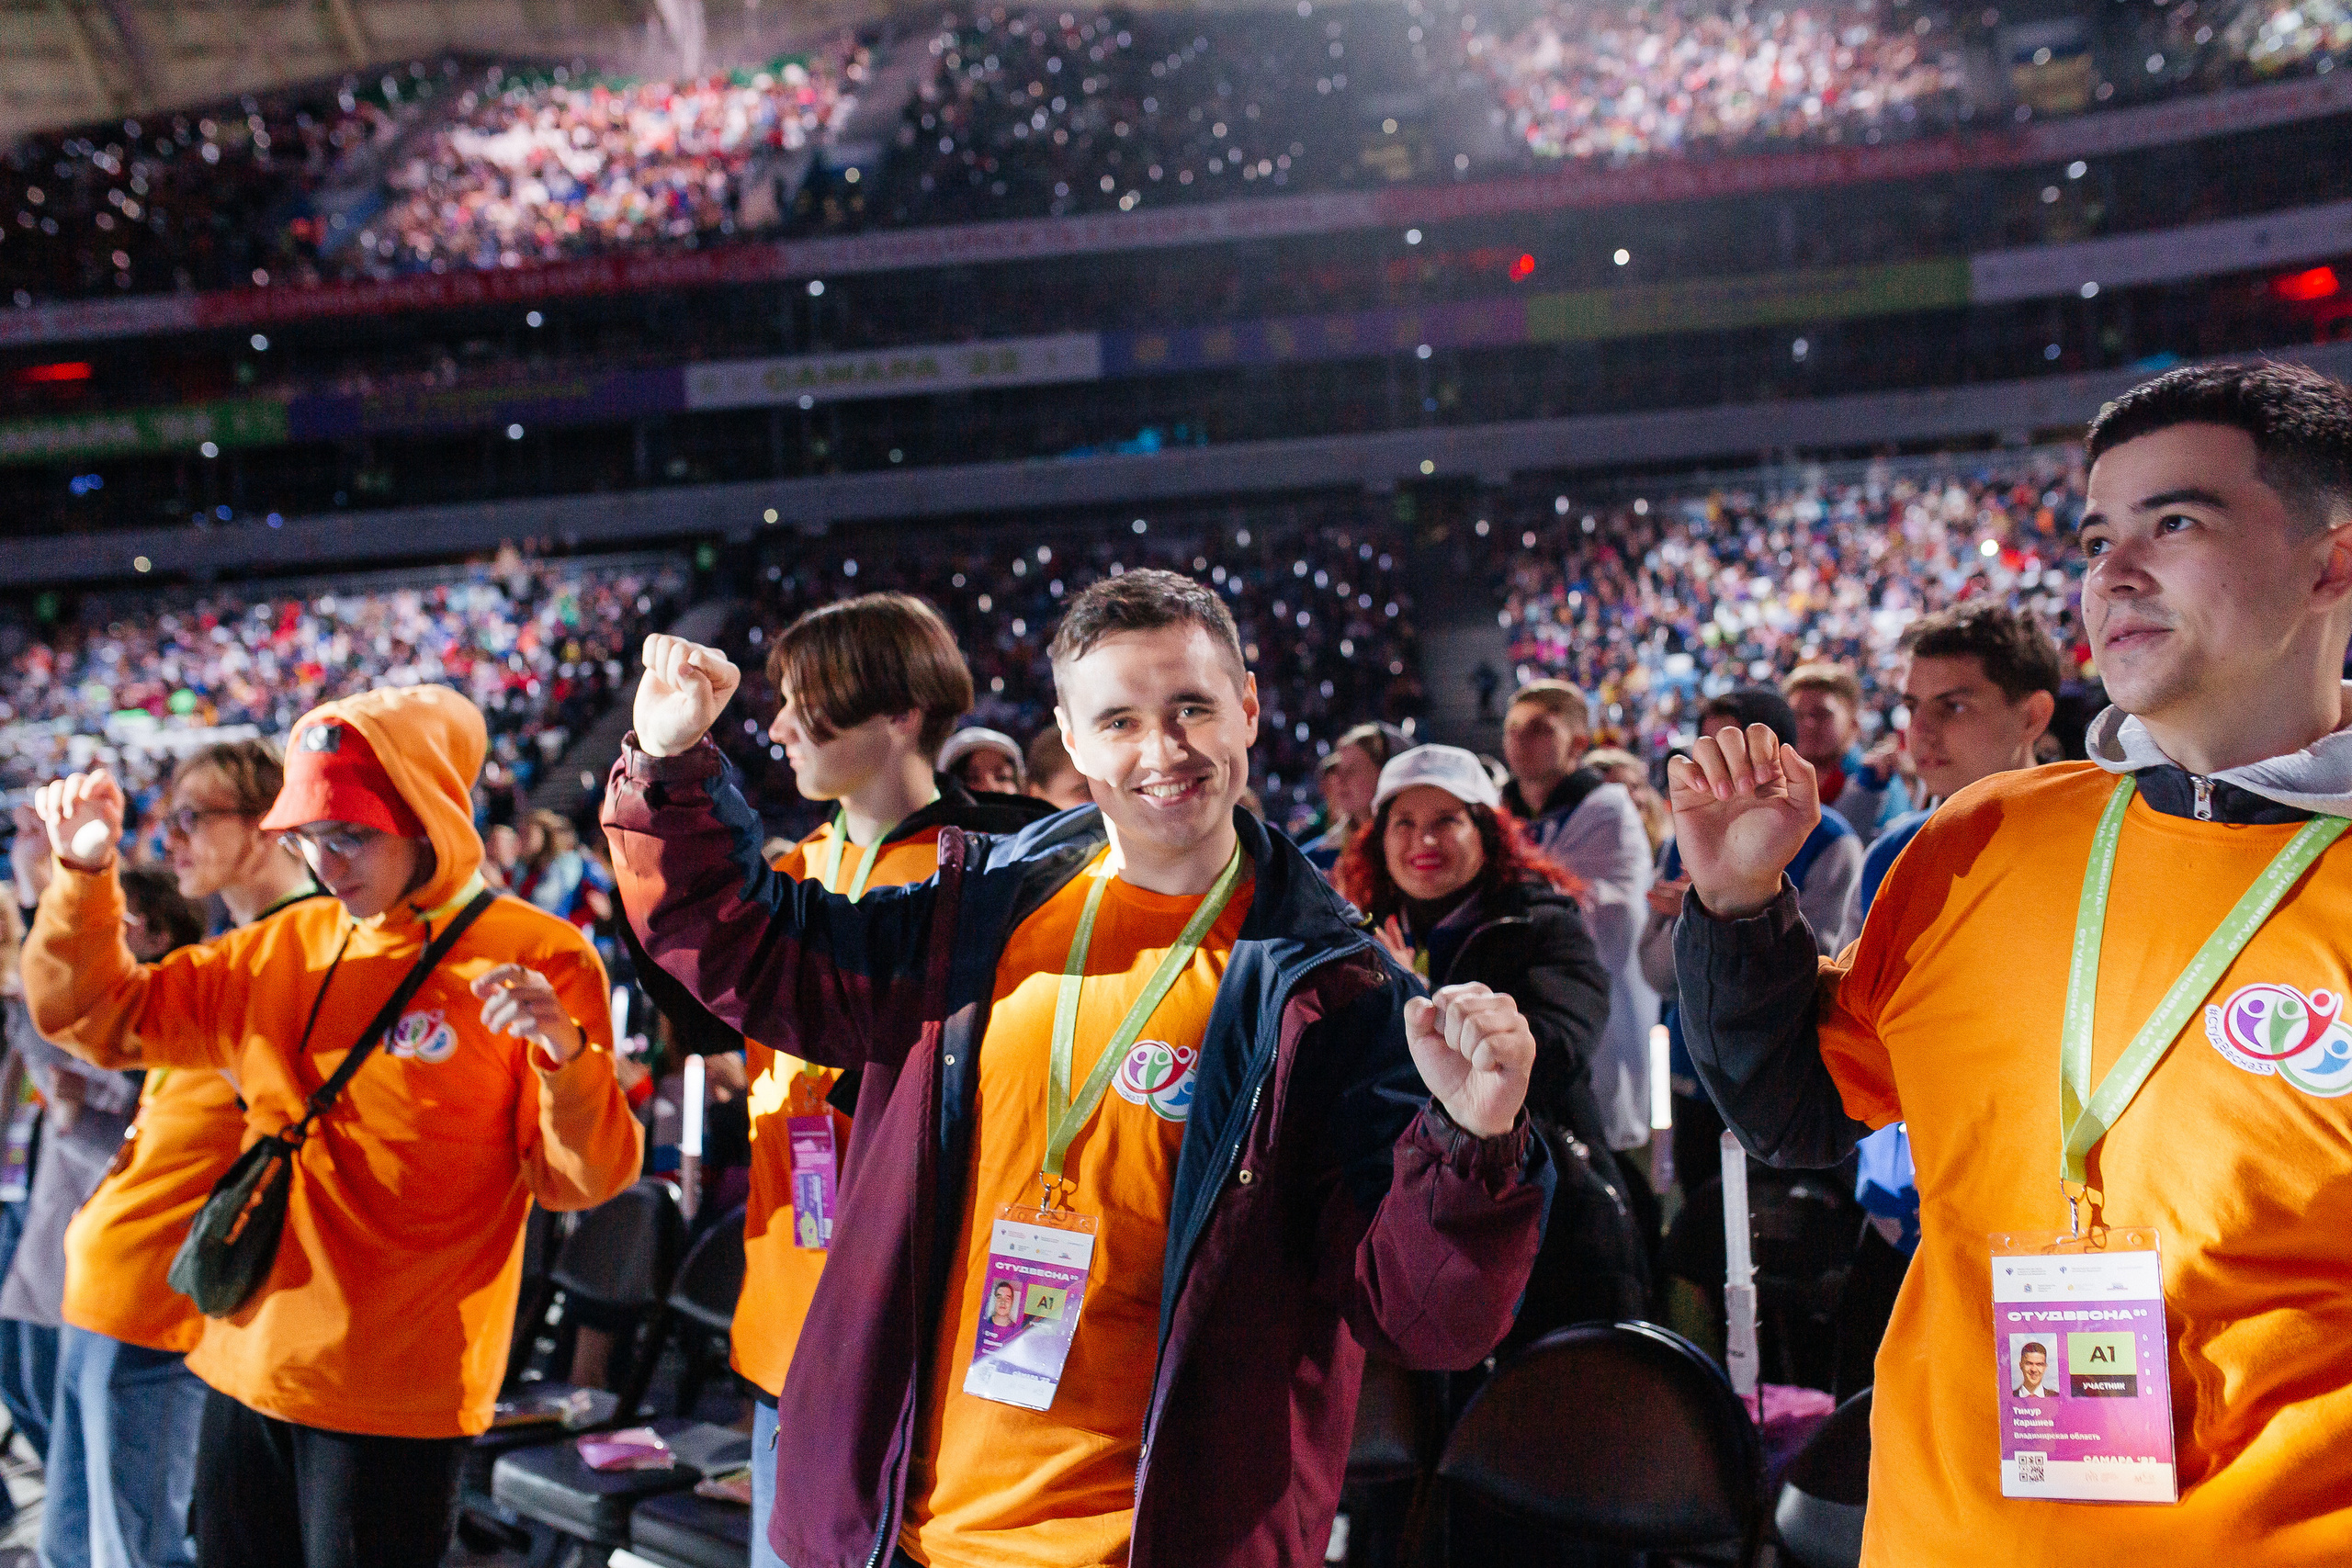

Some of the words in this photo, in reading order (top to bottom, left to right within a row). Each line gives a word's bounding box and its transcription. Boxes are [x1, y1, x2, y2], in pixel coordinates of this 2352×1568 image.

[2082, 1382, 2126, 1391] УЧАСТНИК
[2012, 1406, 2041, 1416] Тимур
[2013, 1432, 2069, 1440] Владимирская
[2069, 1432, 2101, 1440] область
